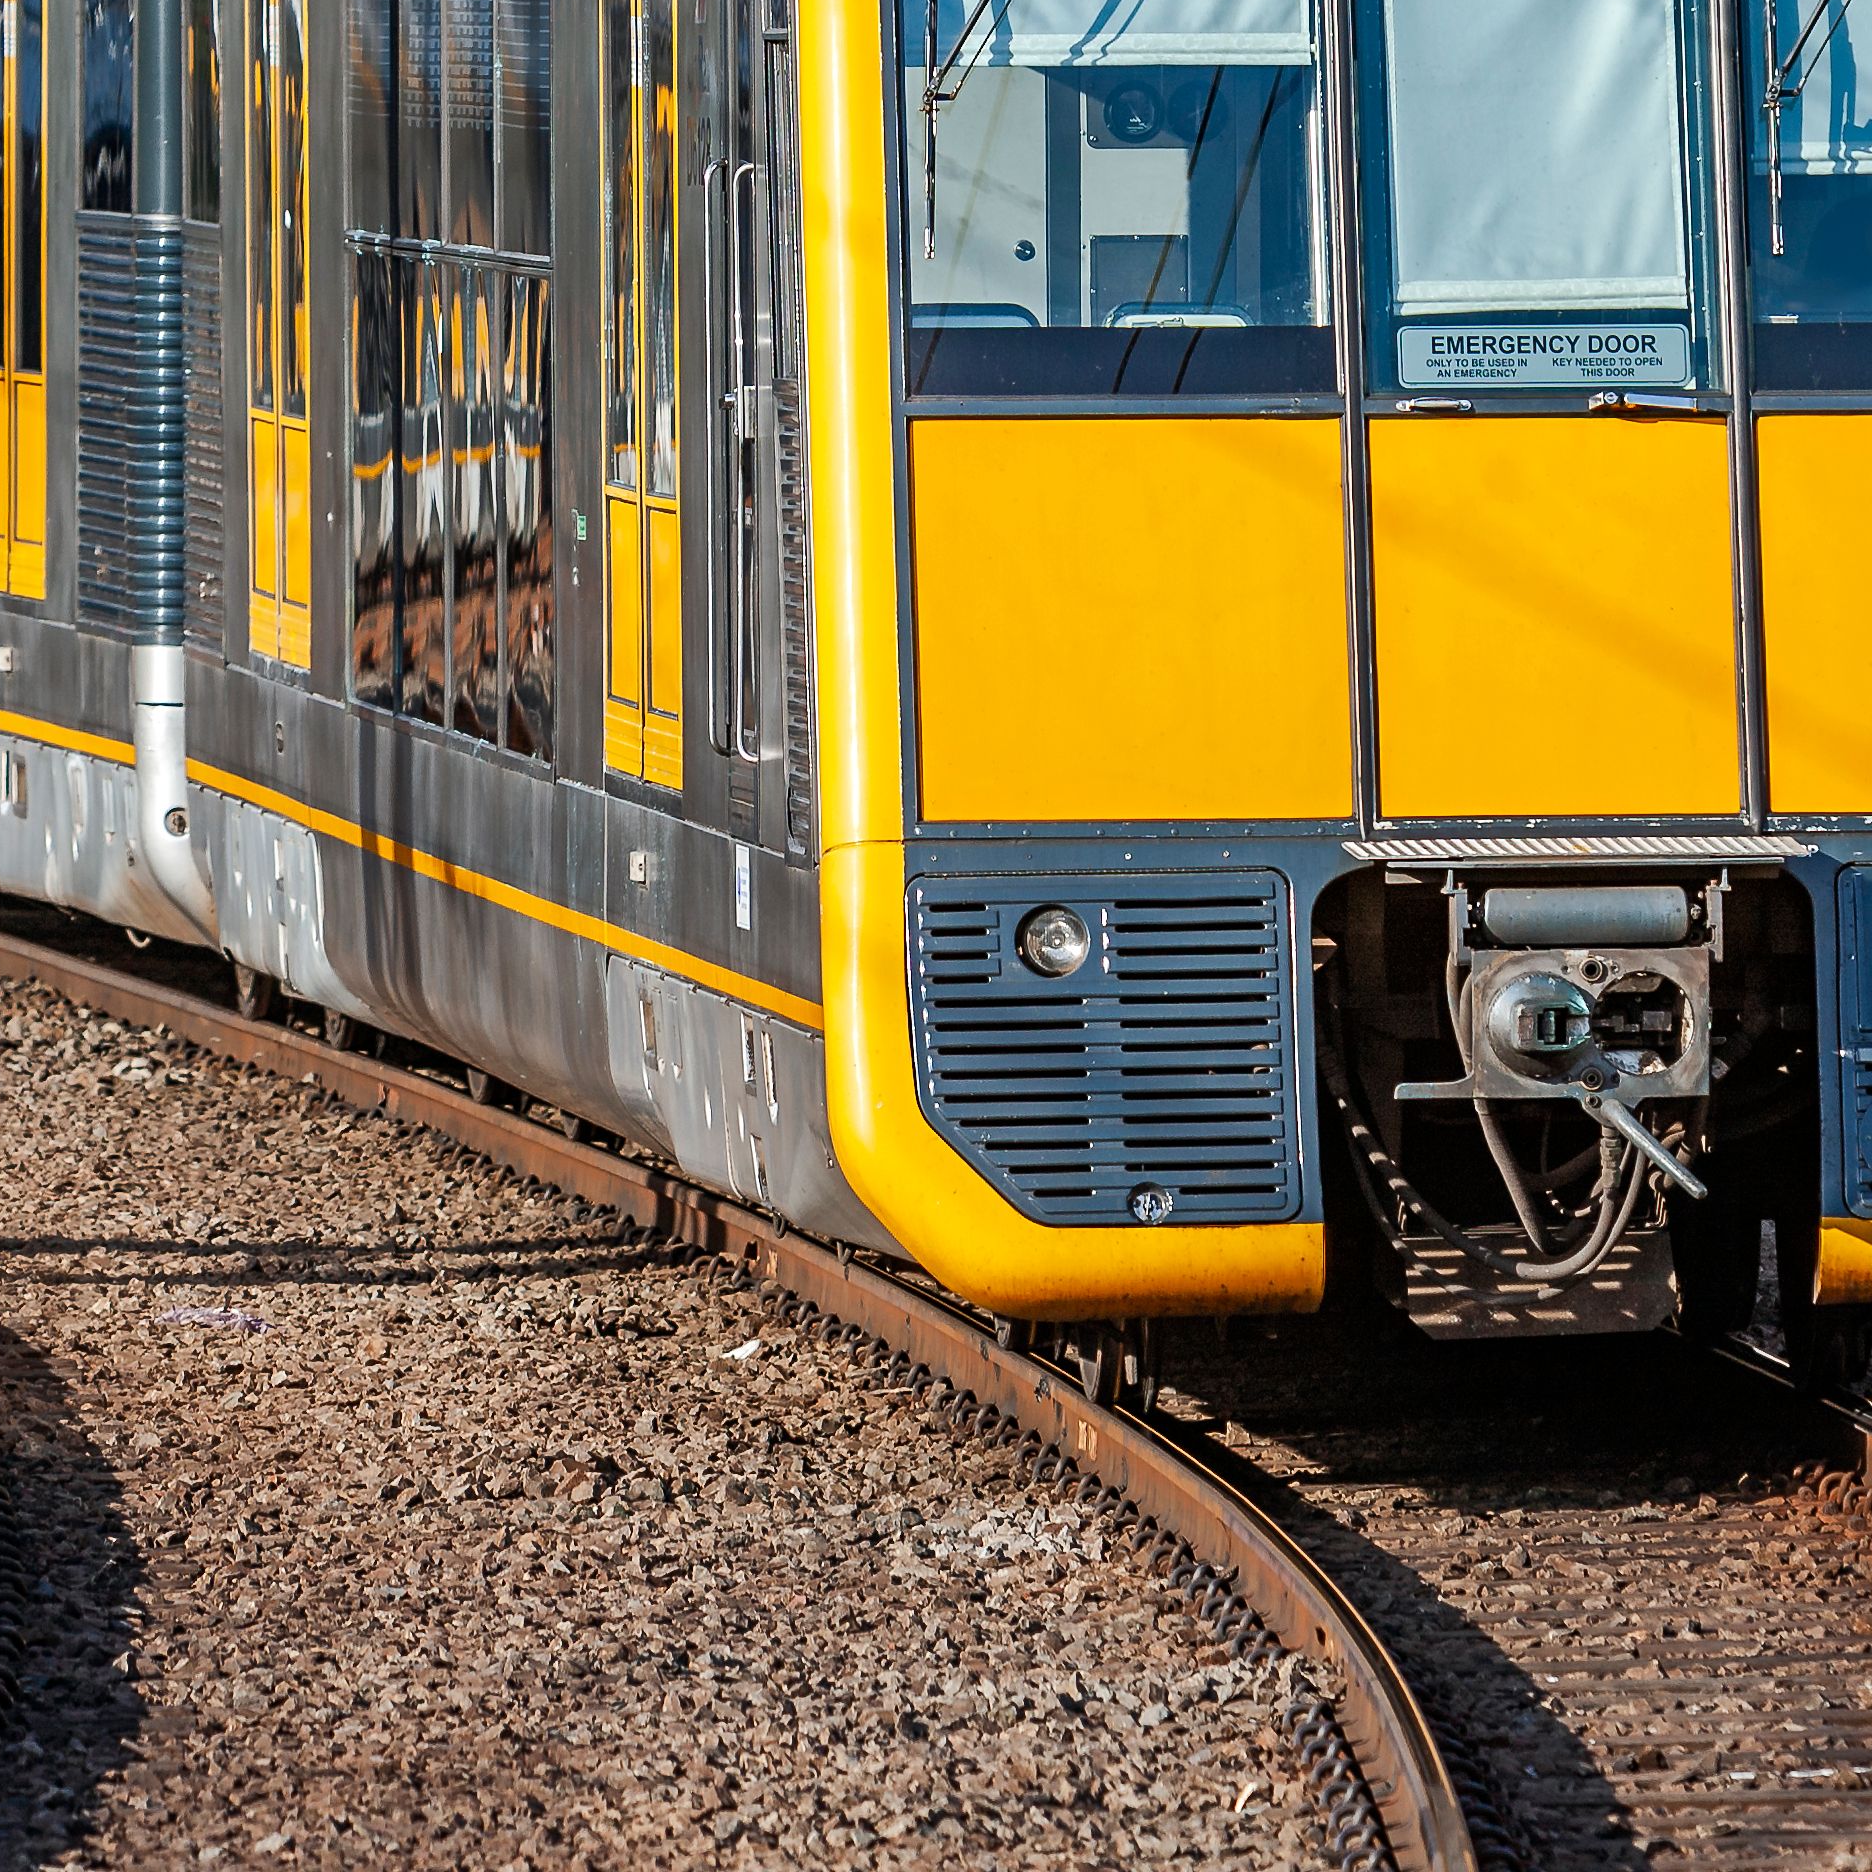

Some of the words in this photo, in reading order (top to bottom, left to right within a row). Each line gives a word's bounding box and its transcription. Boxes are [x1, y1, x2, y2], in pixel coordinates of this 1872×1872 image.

[1431, 334, 1580, 355] EMERGENCY
[1588, 334, 1658, 354] DOOR
[1426, 358, 1452, 368] ONLY
[1455, 358, 1469, 367] TO
[1471, 358, 1485, 367] BE
[1488, 358, 1515, 367] USED
[1517, 358, 1528, 367] IN
[1552, 357, 1572, 367] KEY
[1575, 357, 1616, 367] NEEDED
[1618, 357, 1632, 366] TO
[1634, 357, 1663, 366] OPEN
[1437, 369, 1451, 378] AN
[1454, 368, 1518, 378] EMERGENCY
[1581, 367, 1603, 377] THIS
[1605, 367, 1635, 377] DOOR
